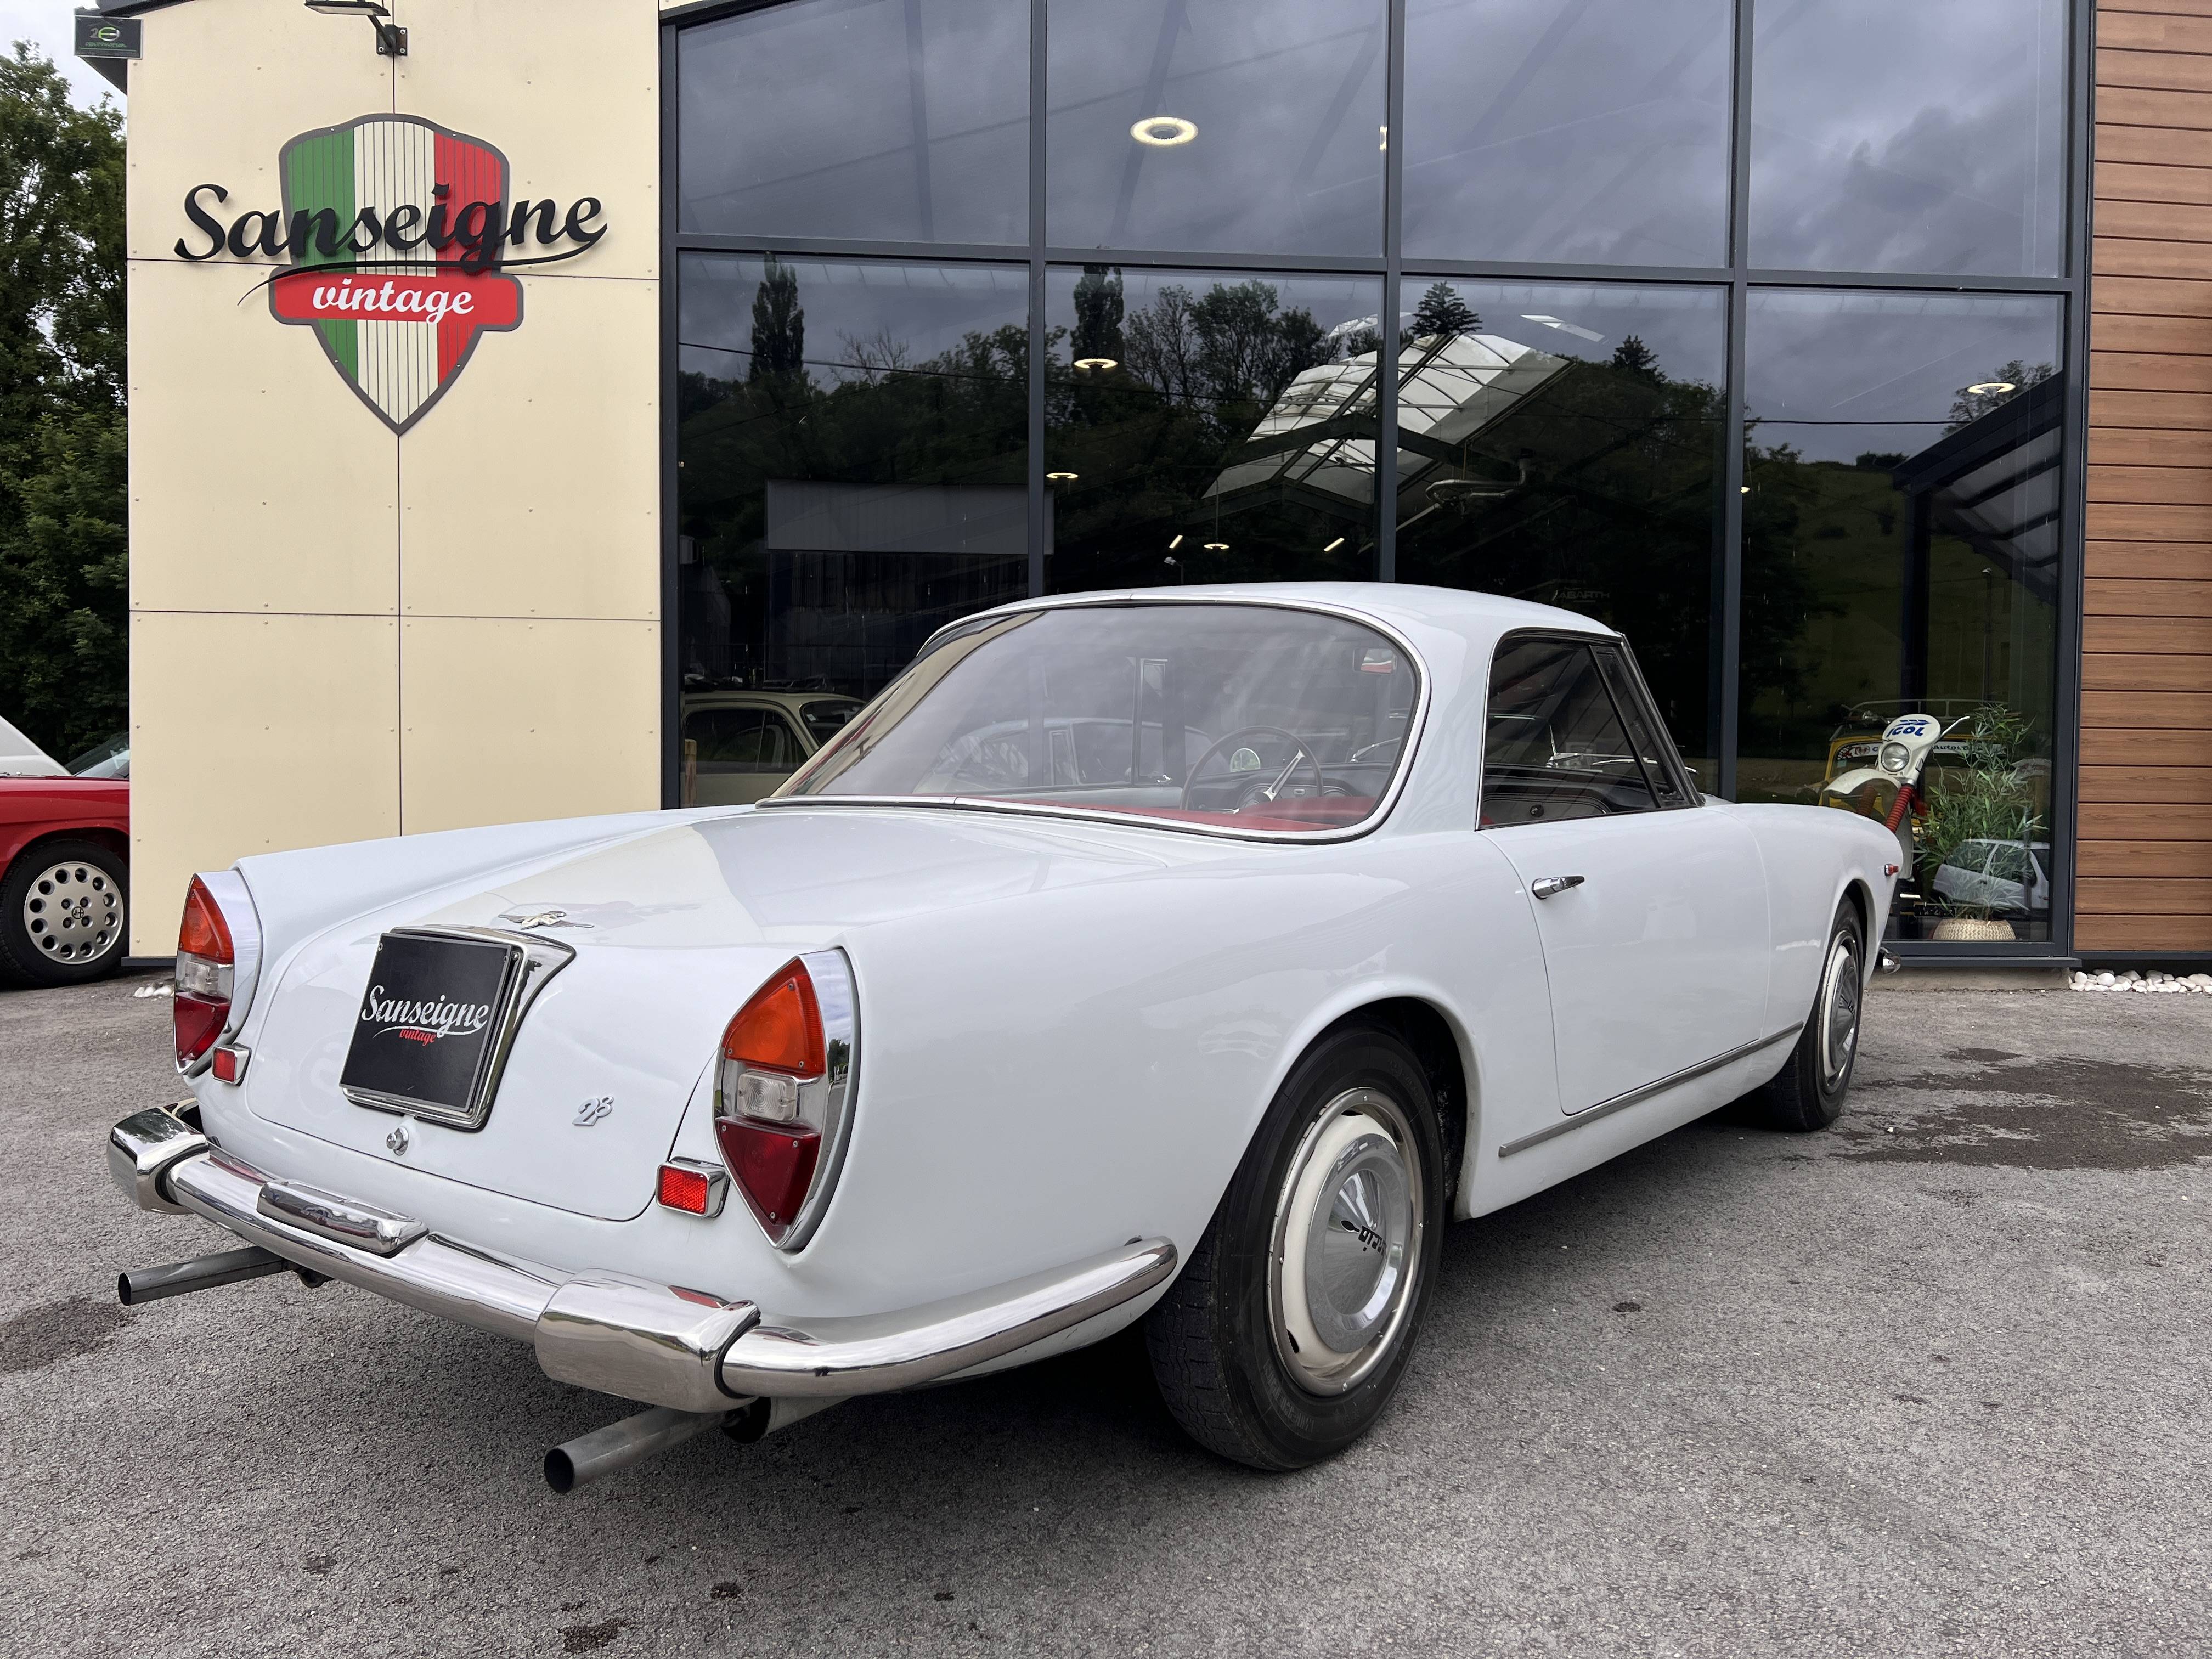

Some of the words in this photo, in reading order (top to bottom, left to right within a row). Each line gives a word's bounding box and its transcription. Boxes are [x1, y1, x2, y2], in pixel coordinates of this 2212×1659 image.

[174, 183, 607, 273] Sanseigne
[313, 278, 475, 324] vintage
[1886, 726, 1925, 737] IGOL
[361, 985, 489, 1038] Sanseigne
[399, 1028, 437, 1046] vintage
